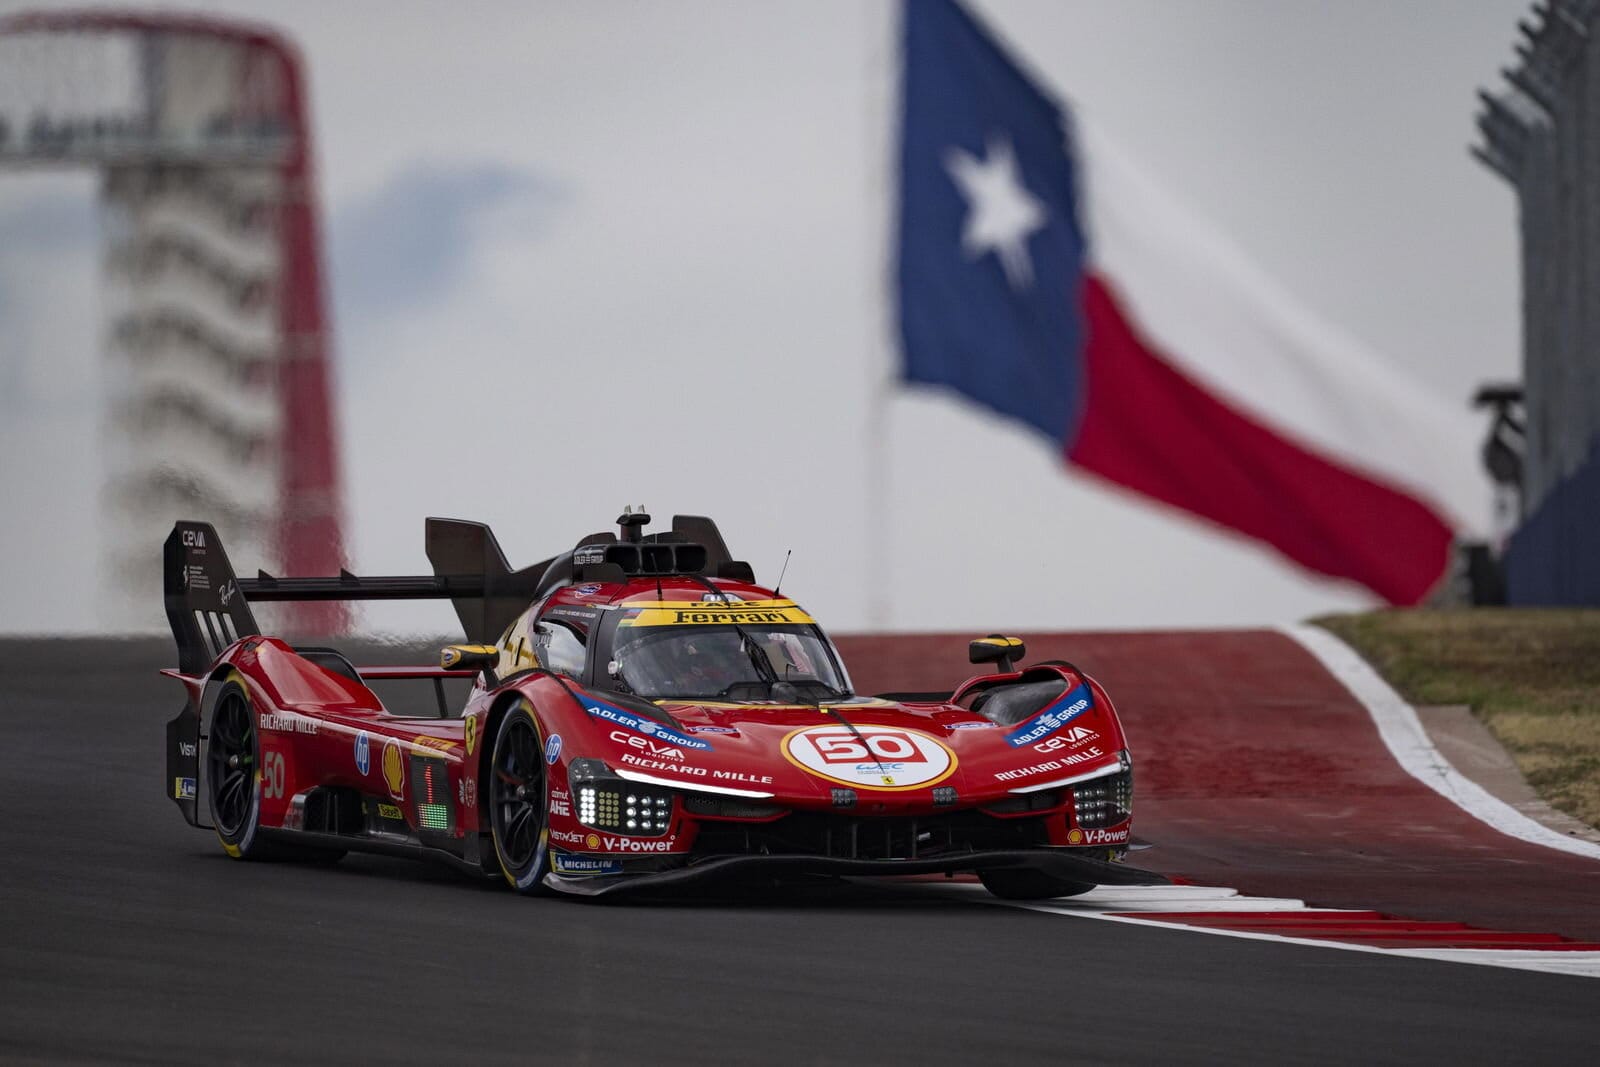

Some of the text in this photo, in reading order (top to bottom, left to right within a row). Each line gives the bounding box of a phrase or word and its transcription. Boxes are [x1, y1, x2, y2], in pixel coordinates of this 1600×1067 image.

[672, 610, 792, 624] Ferrari
[260, 713, 318, 735] RICHARD MILLE
[587, 706, 707, 749] ADLER GROUP
[1013, 725, 1051, 746] ADLER
[1056, 699, 1089, 721] GROUP
[358, 731, 368, 774] hp
[548, 738, 560, 764] hp
[815, 735, 915, 760] 50
[1069, 732, 1101, 750] LOGISTICS
[621, 753, 774, 784] RICHARD MILLE
[641, 750, 684, 763] LOGISTICS
[994, 746, 1104, 782] RICHARD MILLE
[264, 751, 286, 800] 50
[603, 837, 673, 852] V-Power
[1085, 829, 1128, 844] V-Power
[564, 859, 613, 870] MICHELIN
